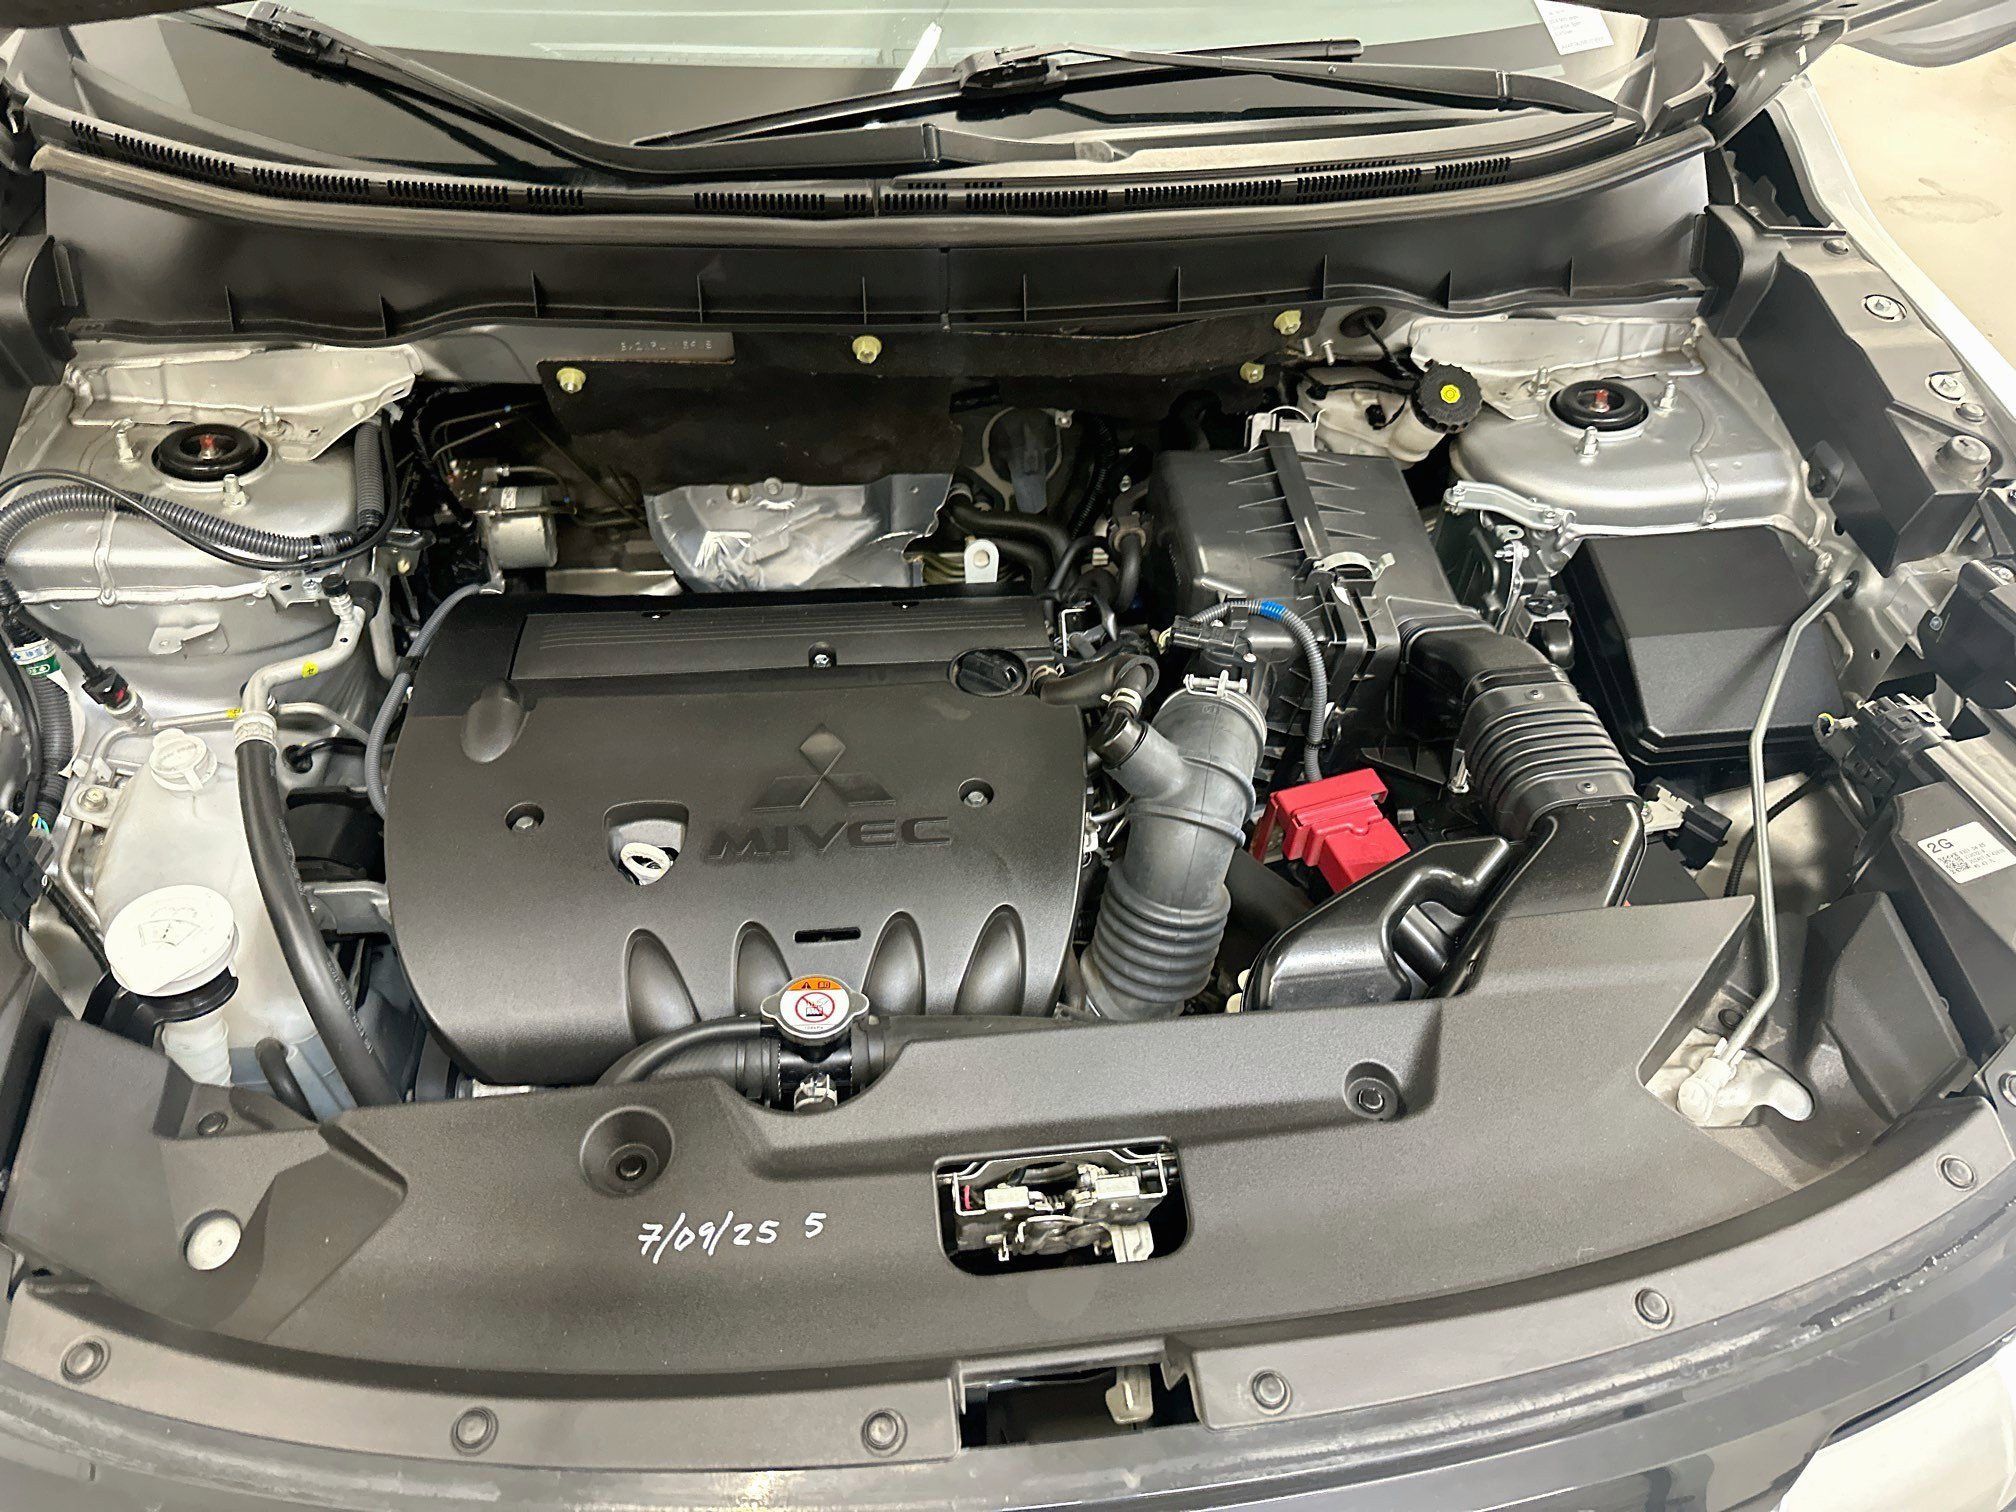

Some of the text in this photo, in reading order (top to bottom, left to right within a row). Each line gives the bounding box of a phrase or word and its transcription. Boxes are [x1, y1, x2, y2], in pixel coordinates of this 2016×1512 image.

[708, 816, 952, 860] MIVEC
[1927, 838, 1954, 854] 2G
[638, 1210, 827, 1264] 7/09/25 5
